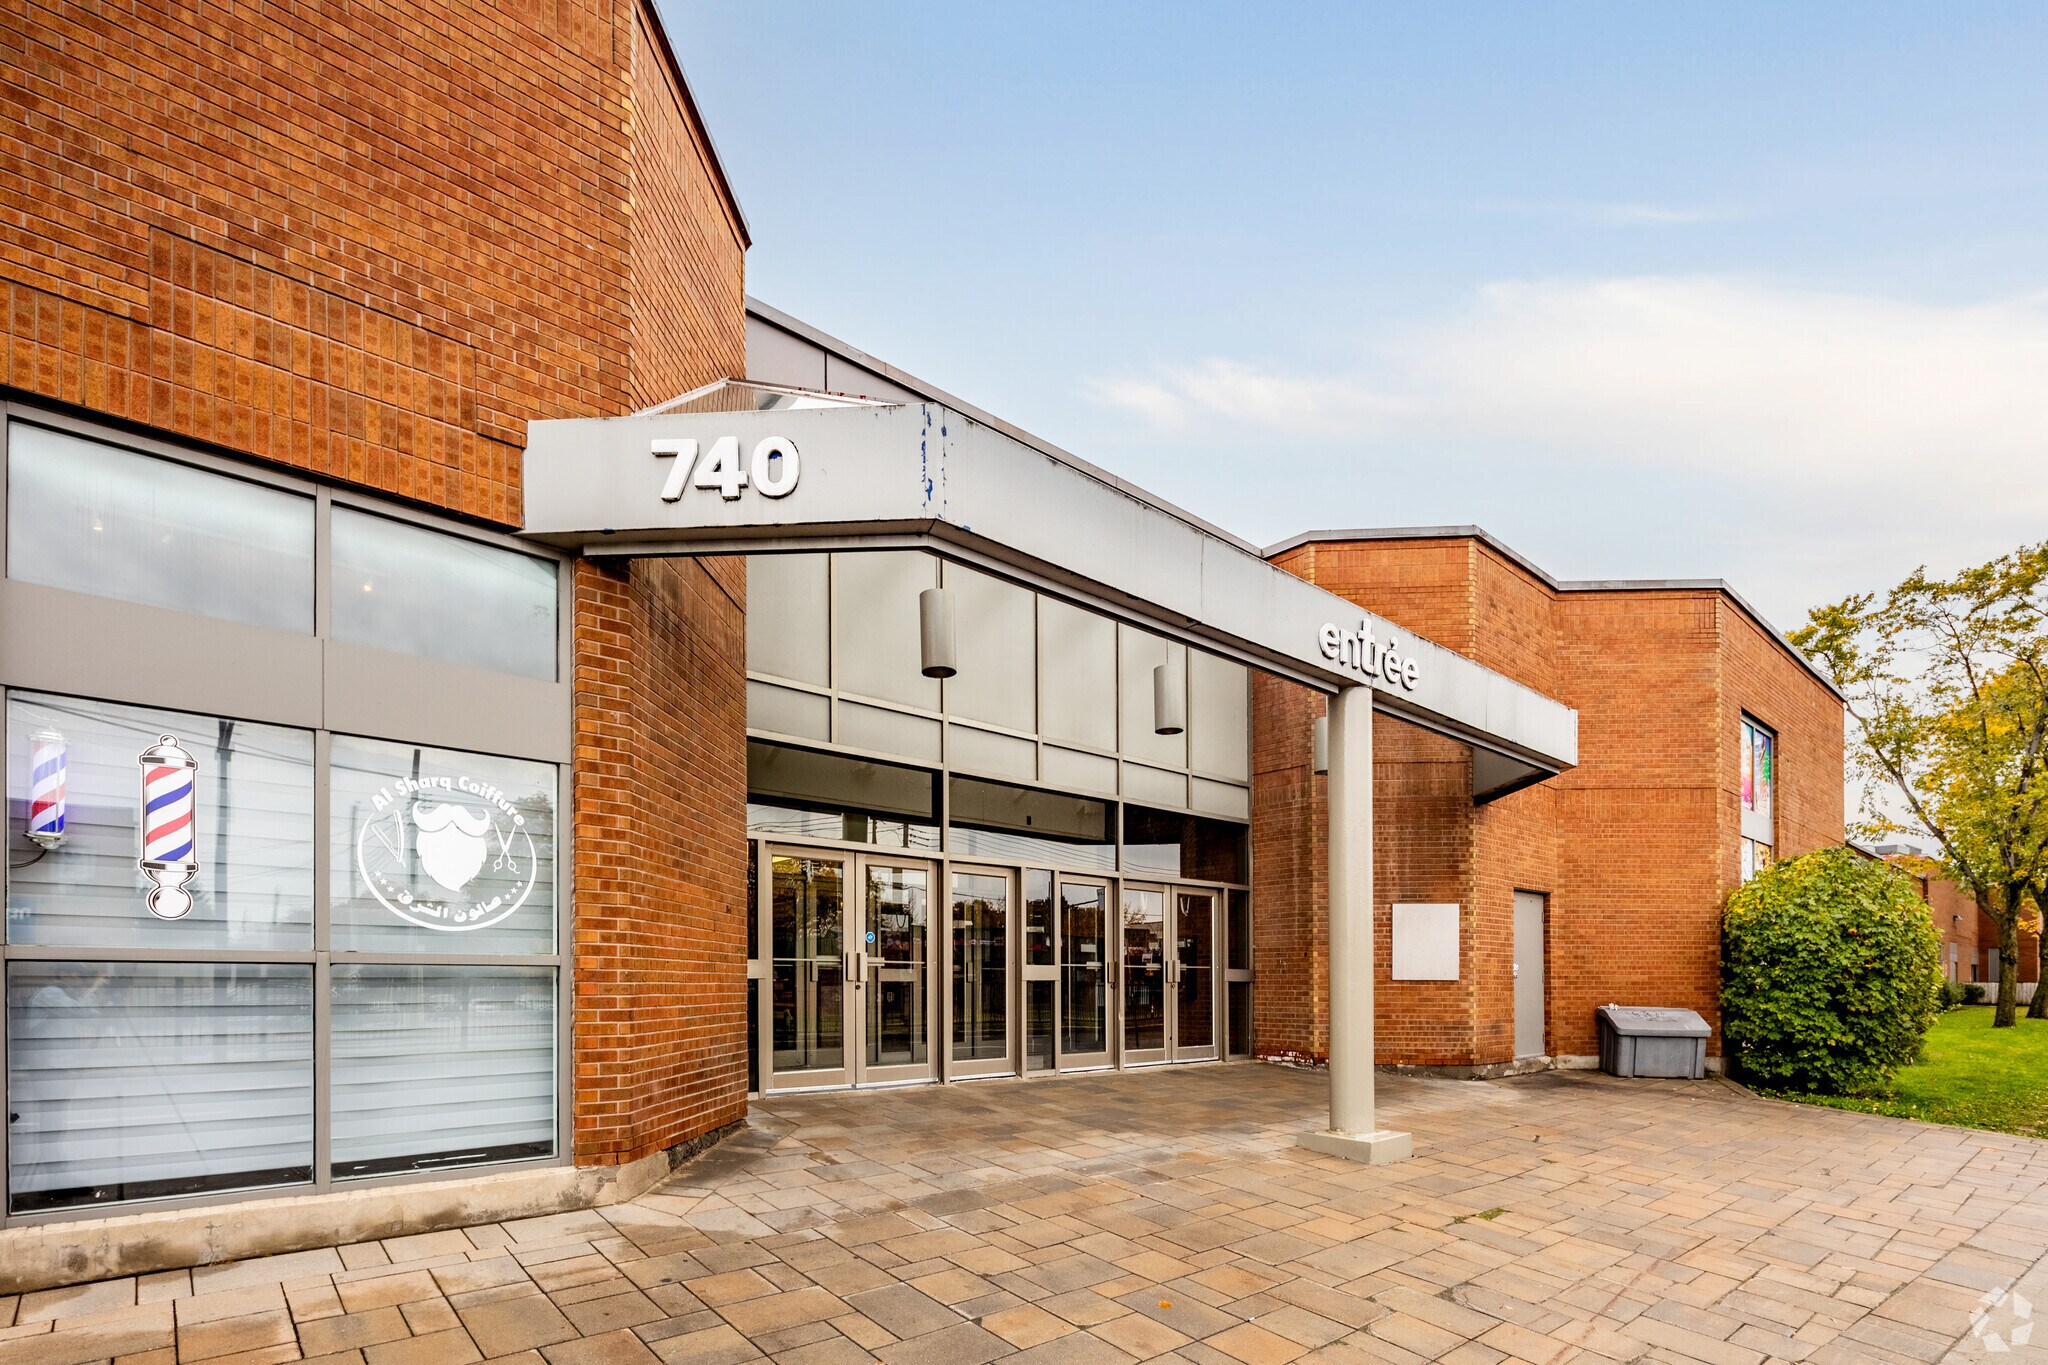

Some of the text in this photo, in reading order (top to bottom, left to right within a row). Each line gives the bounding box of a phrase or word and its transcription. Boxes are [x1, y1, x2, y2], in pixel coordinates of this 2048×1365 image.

[651, 436, 800, 502] 740
[1318, 618, 1420, 691] entrée
[371, 776, 525, 826] Al Sharq Coiffure
[397, 889, 502, 923] صالون الشرق
